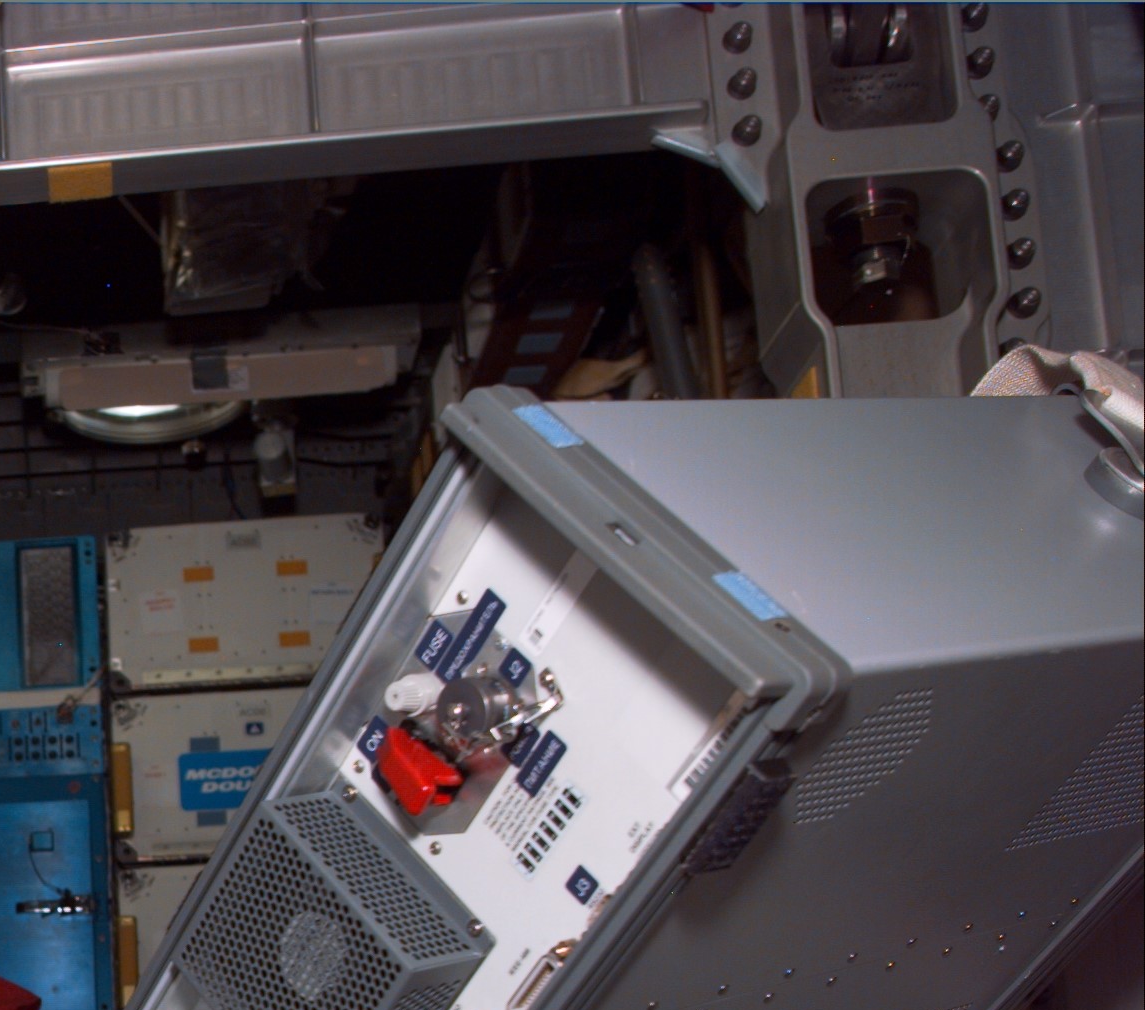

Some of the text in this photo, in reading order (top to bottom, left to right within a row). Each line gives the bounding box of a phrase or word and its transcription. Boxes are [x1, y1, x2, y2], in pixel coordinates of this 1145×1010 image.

[421, 628, 449, 665] FUSE
[366, 729, 384, 752] ON
[522, 738, 562, 790] ПИТАНИЕ
